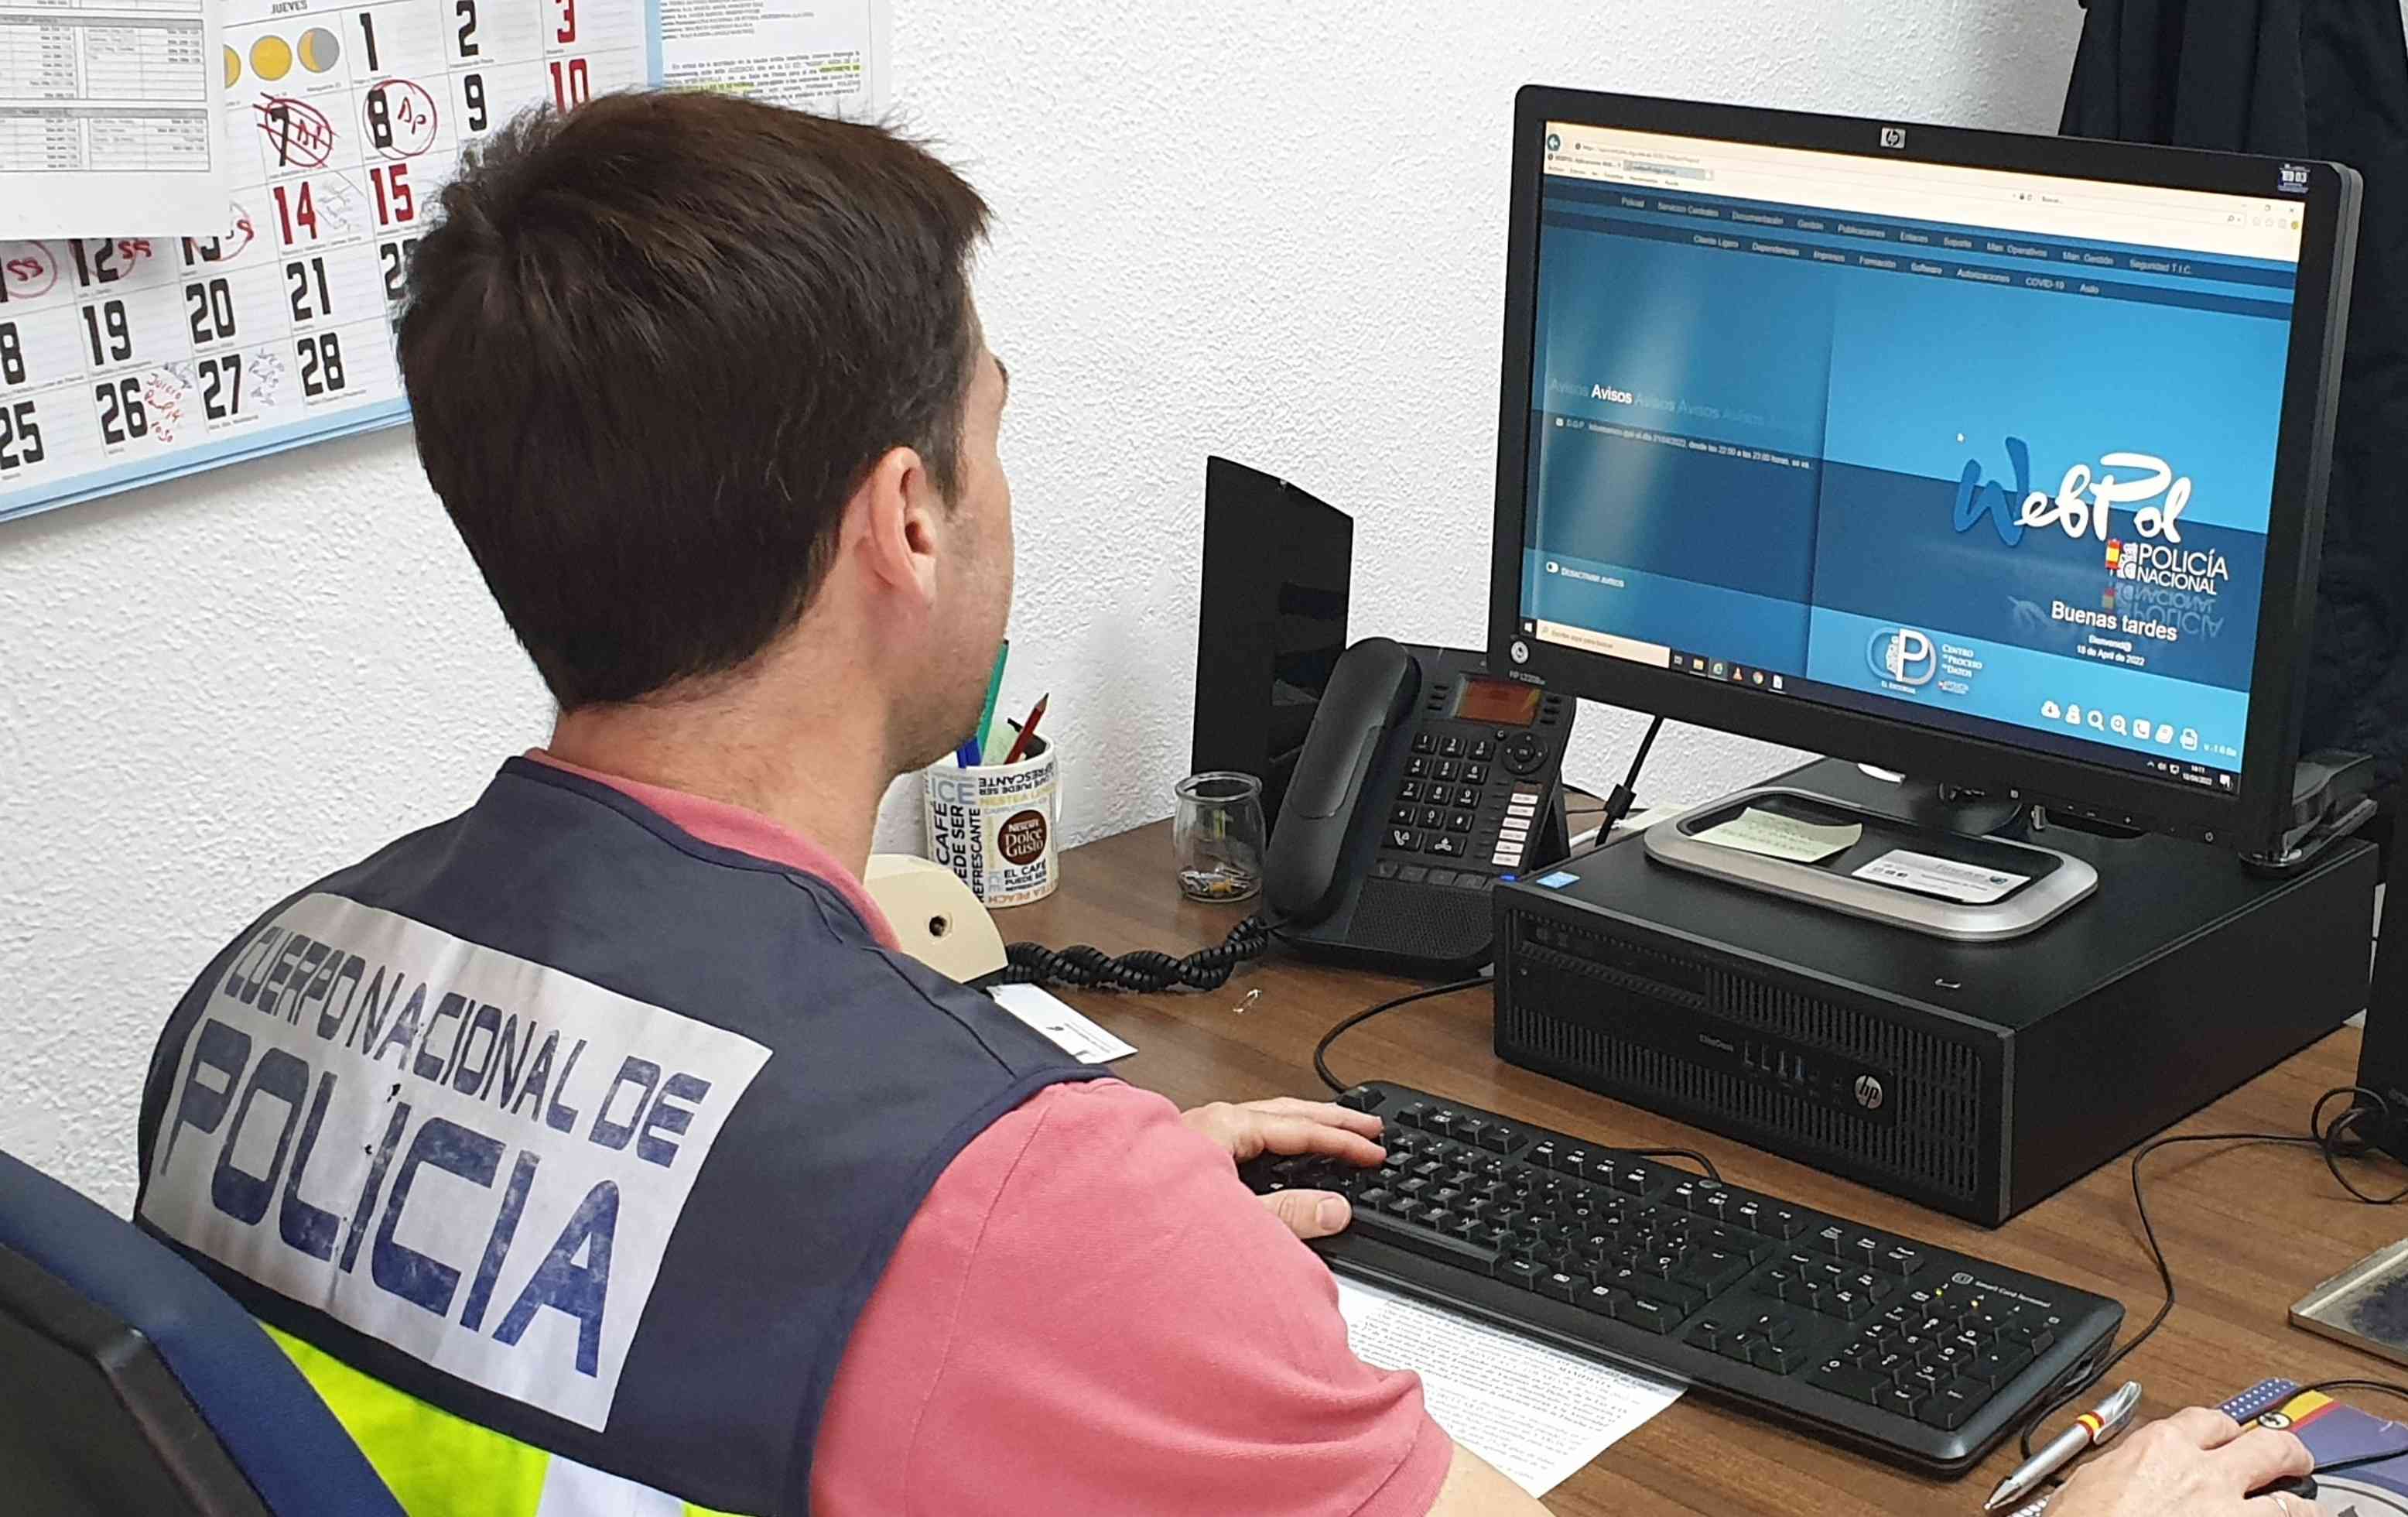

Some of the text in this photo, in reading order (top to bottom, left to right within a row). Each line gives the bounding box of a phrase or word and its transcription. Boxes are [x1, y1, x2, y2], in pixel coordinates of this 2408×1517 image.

[272, 0, 308, 14] JUEVES
[457, 0, 480, 57] 2
[555, 0, 576, 43] 3
[359, 12, 378, 71] 1
[464, 74, 487, 132] 9
[549, 58, 591, 115] 10
[270, 105, 289, 167] 7
[368, 88, 393, 149] 8
[273, 181, 317, 245] 14
[370, 163, 414, 225] 15
[71, 238, 119, 287] 12
[287, 257, 332, 322] 21
[2025, 276, 2065, 289] COVID-19
[83, 300, 132, 366] 19
[186, 278, 236, 344] 20
[199, 354, 242, 420] 27
[297, 332, 345, 397] 28
[96, 378, 149, 445] 26
[1591, 383, 1633, 404] Avisos
[0, 400, 44, 471] 25
[1953, 435, 2191, 547] WebPol
[2136, 565, 2218, 596] NACIONAL
[2137, 542, 2229, 581] POLICÍA
[2051, 600, 2178, 642] Buenas tardes
[2087, 648, 2097, 657] de
[2115, 653, 2126, 663] de
[930, 777, 976, 806] ICE
[931, 800, 950, 866] CAFÉ
[950, 804, 966, 840] SER
[1004, 828, 1043, 848] Dolce
[1005, 840, 1044, 858] Gusto
[1004, 868, 1018, 879] EL
[223, 926, 713, 1169] CUERPO NACIONAL DE
[1855, 1074, 1883, 1110] hp
[159, 1018, 621, 1380] POLICIA
[1975, 1281, 1999, 1292] Smart
[1999, 1287, 2018, 1298] Card
